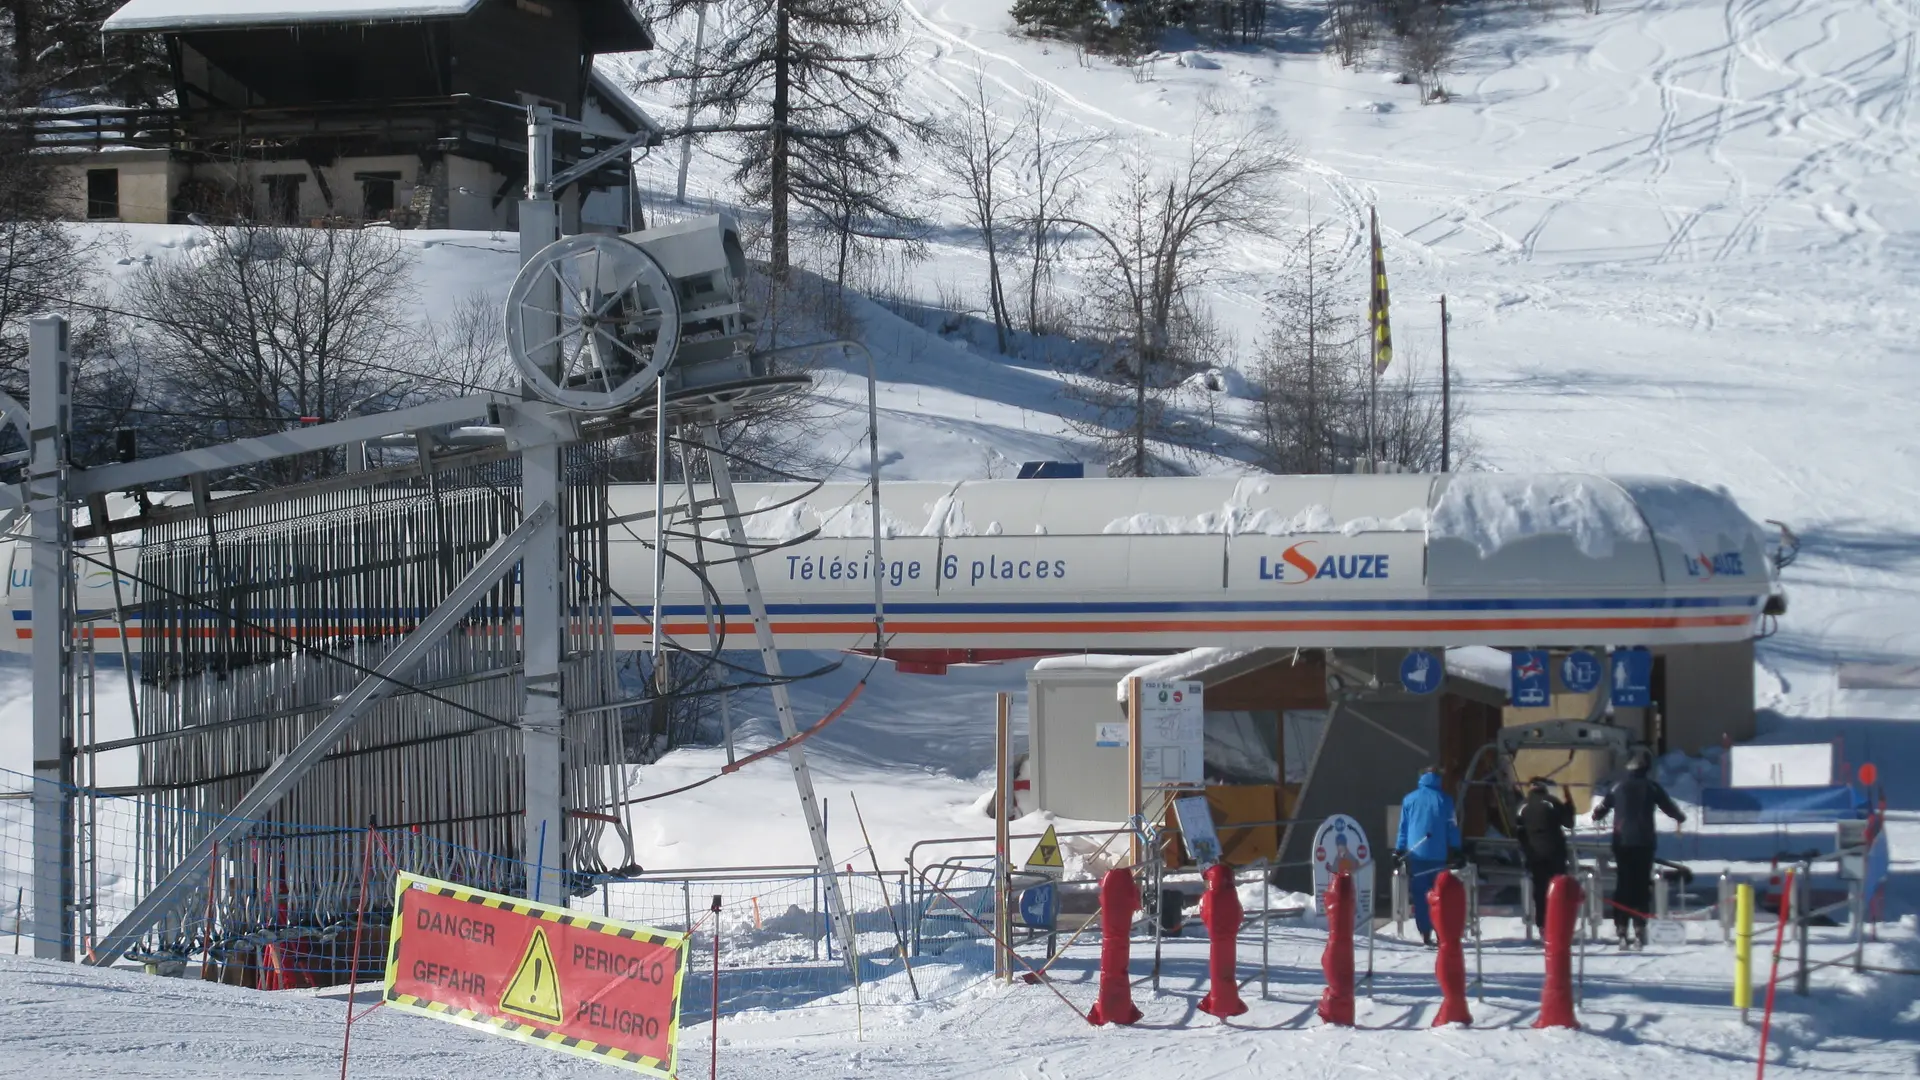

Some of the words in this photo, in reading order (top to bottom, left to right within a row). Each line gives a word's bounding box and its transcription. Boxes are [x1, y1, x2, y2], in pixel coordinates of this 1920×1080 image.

[943, 554, 959, 580] 6
[971, 554, 1066, 587] places
[1279, 540, 1390, 585] SAUZE
[416, 908, 496, 947] DANGER
[413, 960, 486, 997] GEFAHR
[573, 943, 664, 986] PERICOLO
[577, 1000, 659, 1041] PELIGRO
